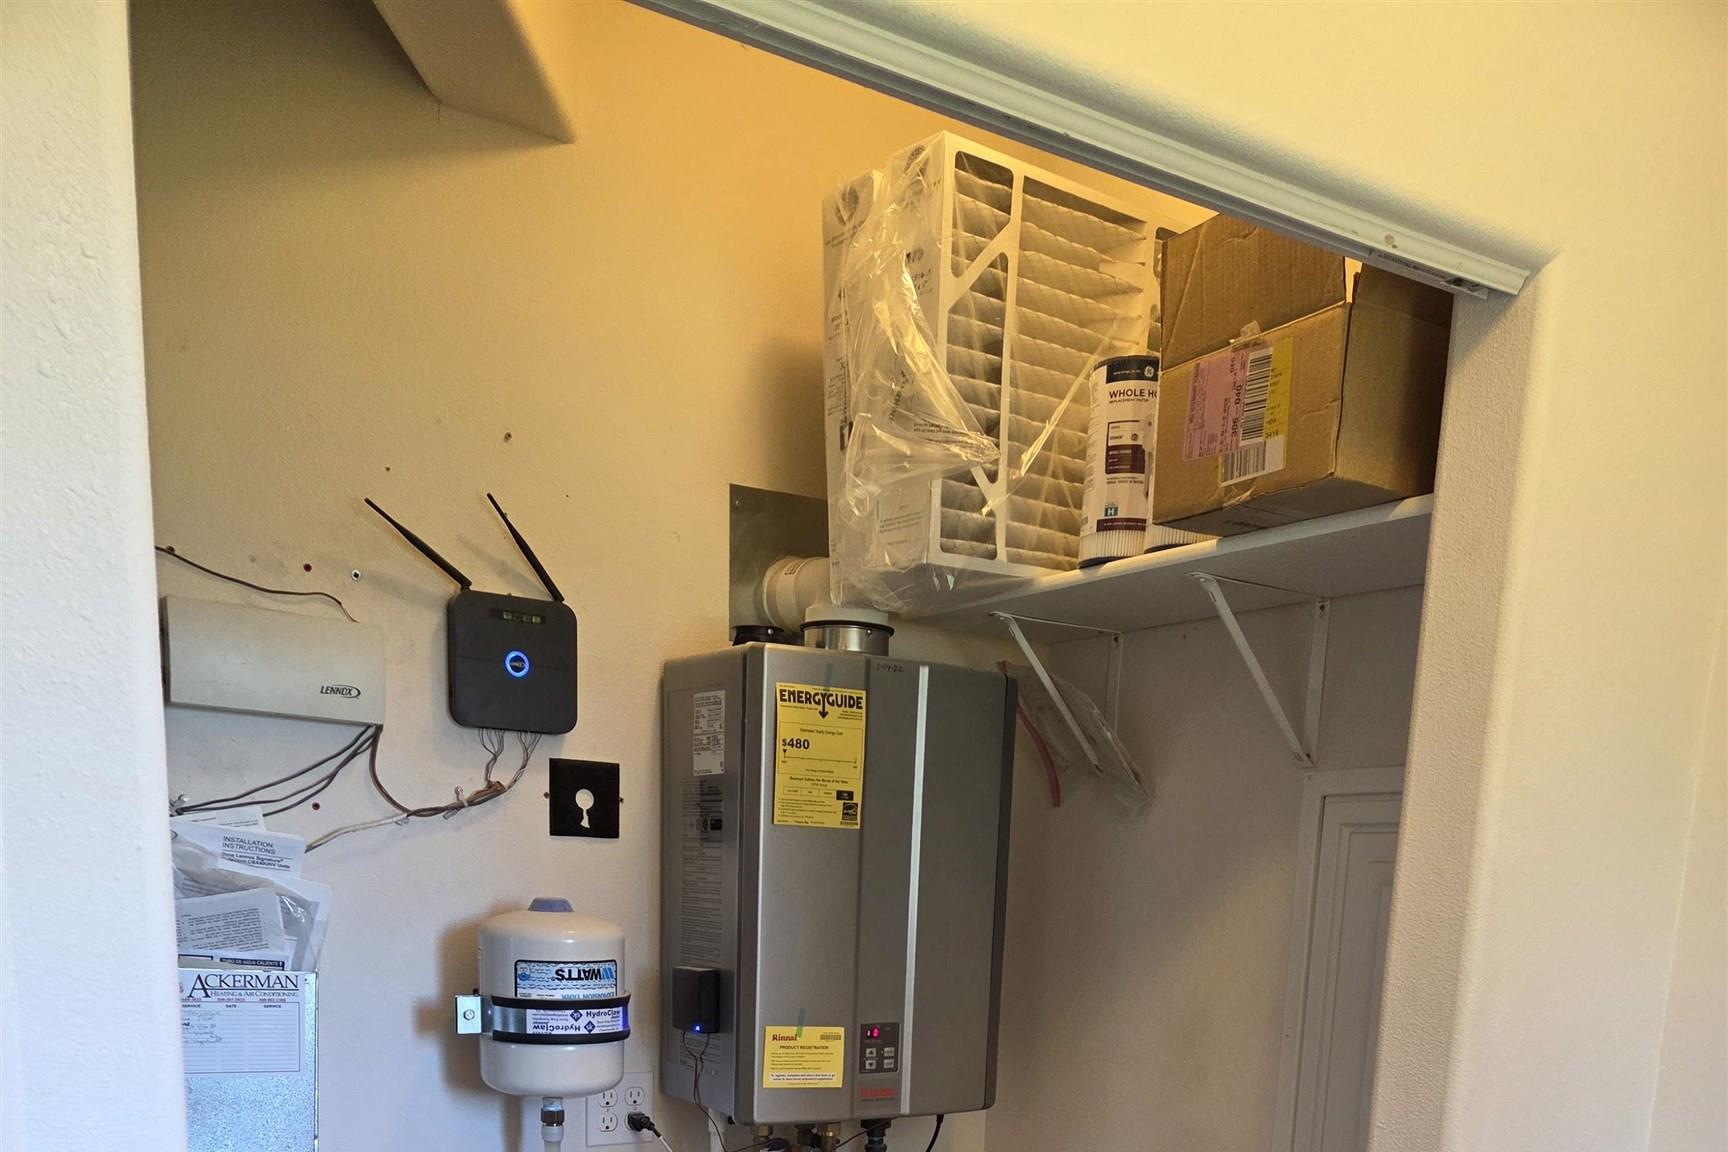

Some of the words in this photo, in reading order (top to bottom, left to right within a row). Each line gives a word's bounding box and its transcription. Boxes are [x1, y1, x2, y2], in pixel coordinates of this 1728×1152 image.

[1109, 388, 1146, 399] WHOLE
[320, 685, 353, 696] LENNOX
[782, 738, 810, 750] $480
[223, 835, 274, 848] INSTALLATION
[222, 842, 276, 855] INSTRUCTIONS
[555, 967, 602, 981] WATTS
[187, 973, 299, 998] ACKERMAN
[532, 1023, 581, 1032] HydroClaw
